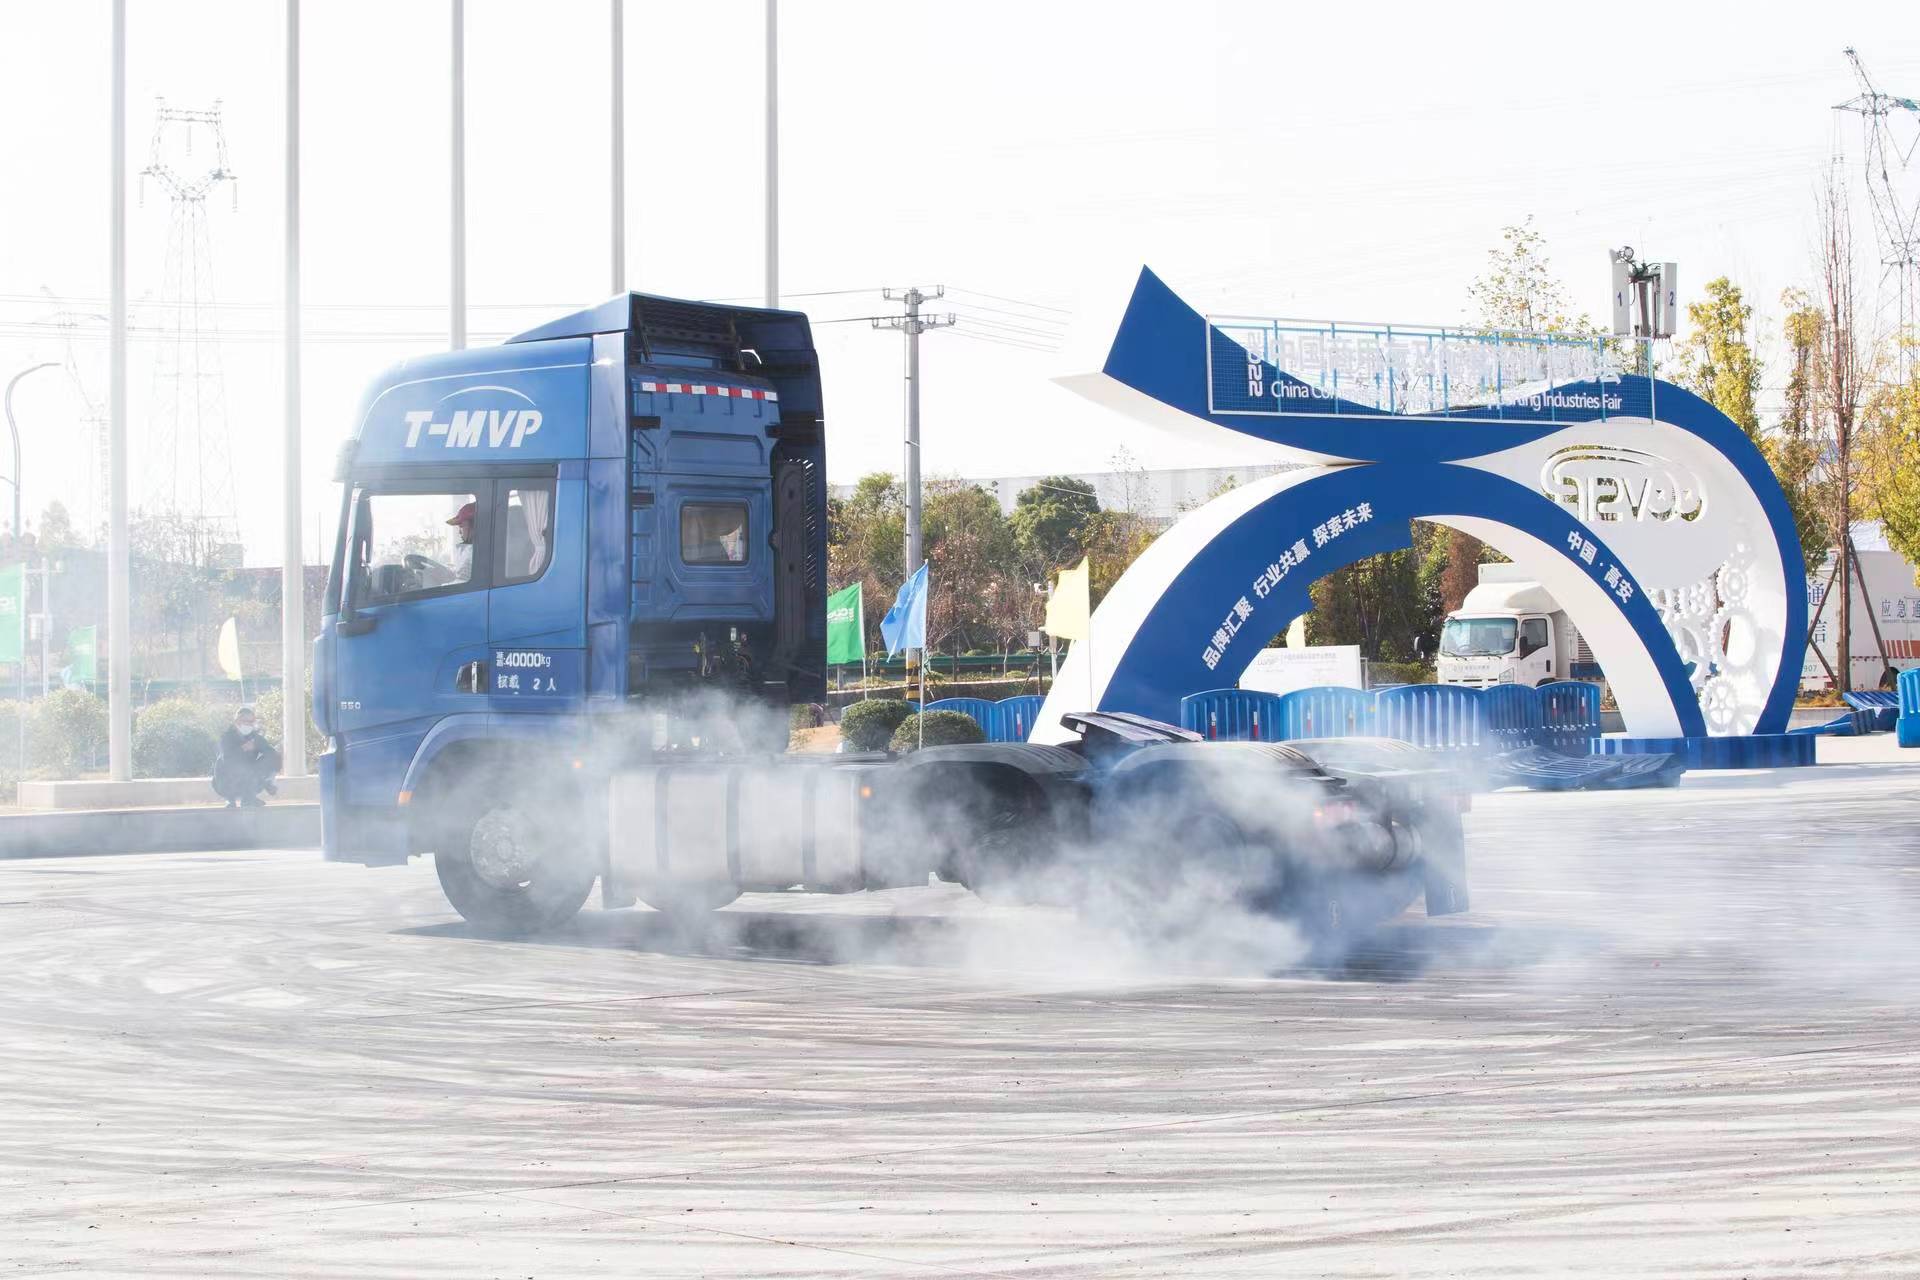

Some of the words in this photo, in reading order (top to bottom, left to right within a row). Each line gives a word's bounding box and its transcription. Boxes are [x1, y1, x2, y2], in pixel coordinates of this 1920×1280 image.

[1669, 291, 1674, 306] 2
[1271, 381, 1309, 398] China
[1543, 391, 1600, 409] Industries
[1602, 393, 1622, 409] Fair
[404, 410, 543, 448] T-MVP
[1202, 595, 1254, 671] 品牌汇聚
[1253, 538, 1311, 599] 行业共赢
[1312, 502, 1373, 548] 探索未来
[533, 678, 540, 690] 2
[546, 678, 556, 691] 人
[340, 701, 361, 710] 550
